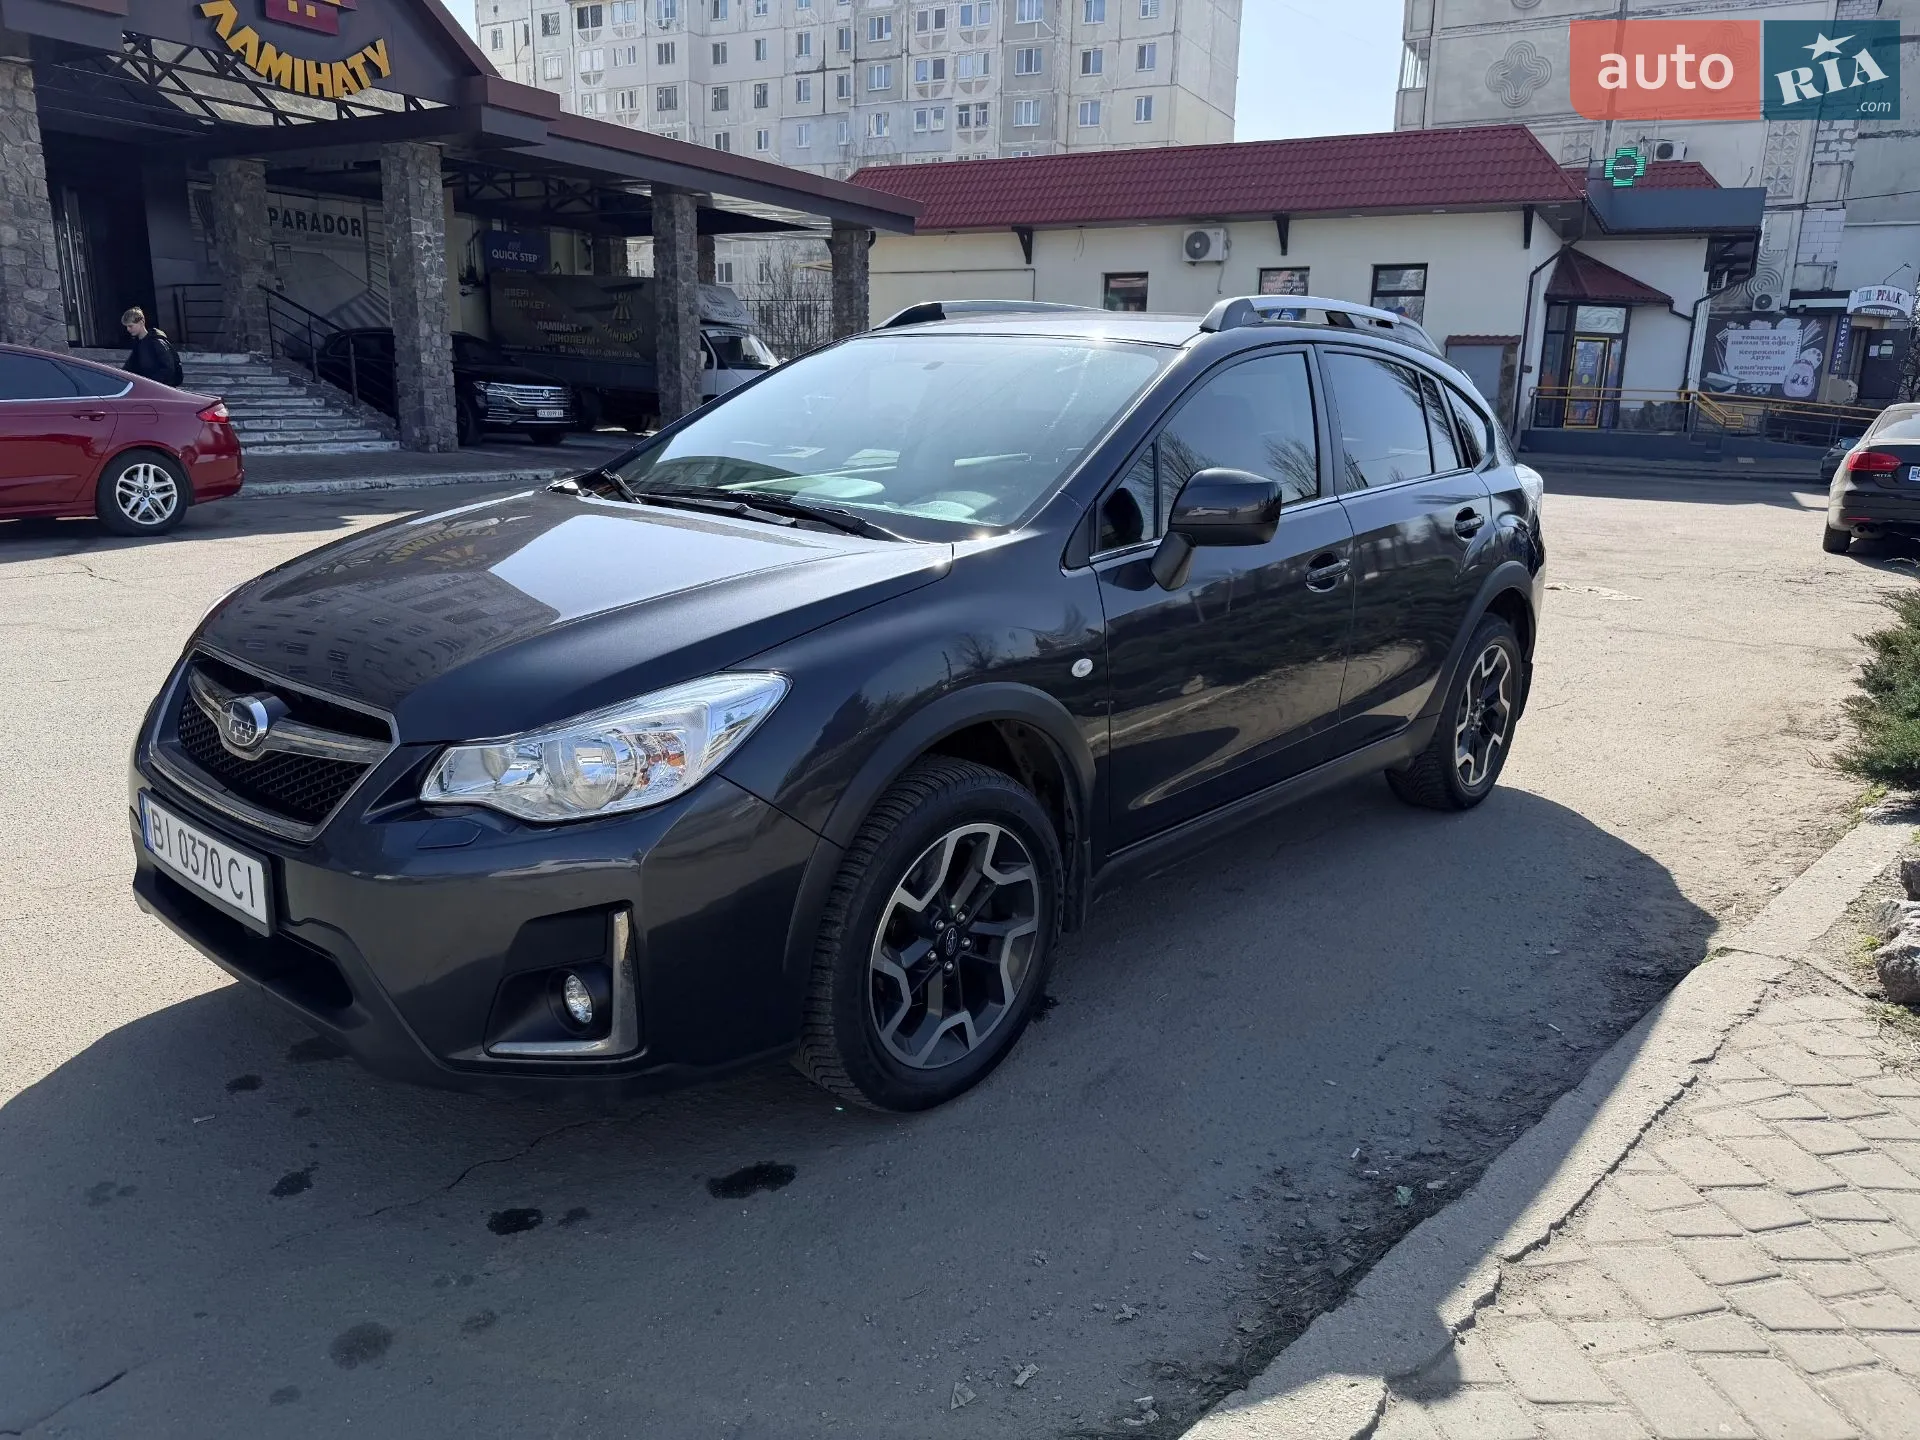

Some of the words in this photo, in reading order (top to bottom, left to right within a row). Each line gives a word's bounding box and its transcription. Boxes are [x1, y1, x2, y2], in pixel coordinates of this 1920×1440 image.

[199, 0, 391, 99] ЛАМІНАТУ
[267, 207, 362, 238] PARADOR
[491, 248, 519, 262] QUICK
[519, 252, 538, 264] STEP
[511, 299, 546, 310] ПАРКЕТ
[536, 320, 579, 333] ЛАМІНАТ
[548, 333, 596, 346] ЛІНОЛЕУМ
[150, 807, 172, 858] BI
[177, 827, 223, 889] 0370
[228, 857, 255, 908] CI
